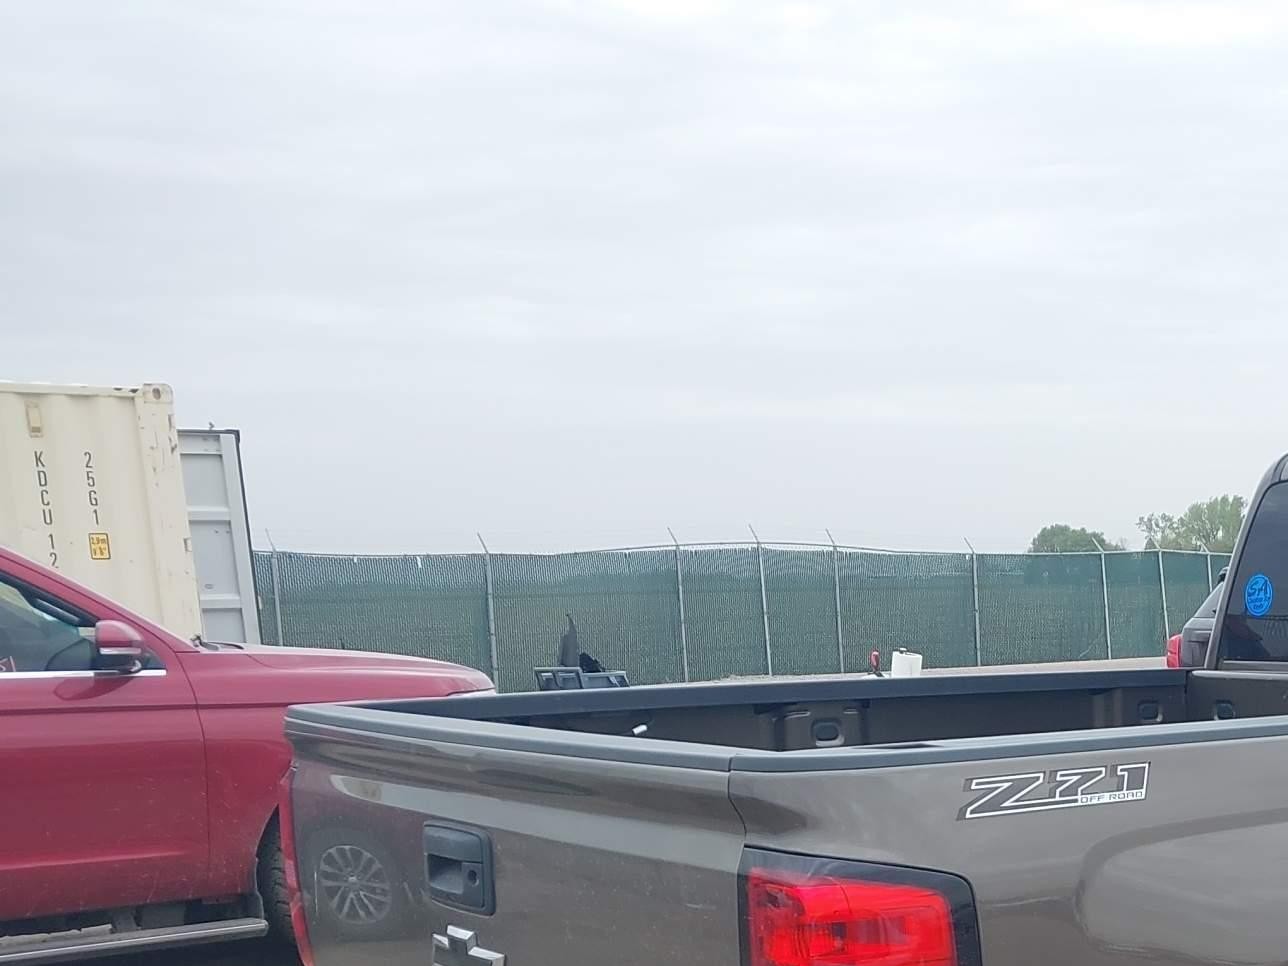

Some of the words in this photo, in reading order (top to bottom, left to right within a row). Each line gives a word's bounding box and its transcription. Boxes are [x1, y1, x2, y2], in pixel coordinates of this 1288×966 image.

[34, 450, 53, 525] KDCU
[84, 451, 99, 525] 25G1
[957, 761, 1151, 820] Z71
[1080, 795, 1105, 804] OFF
[1109, 791, 1143, 801] ROAD
